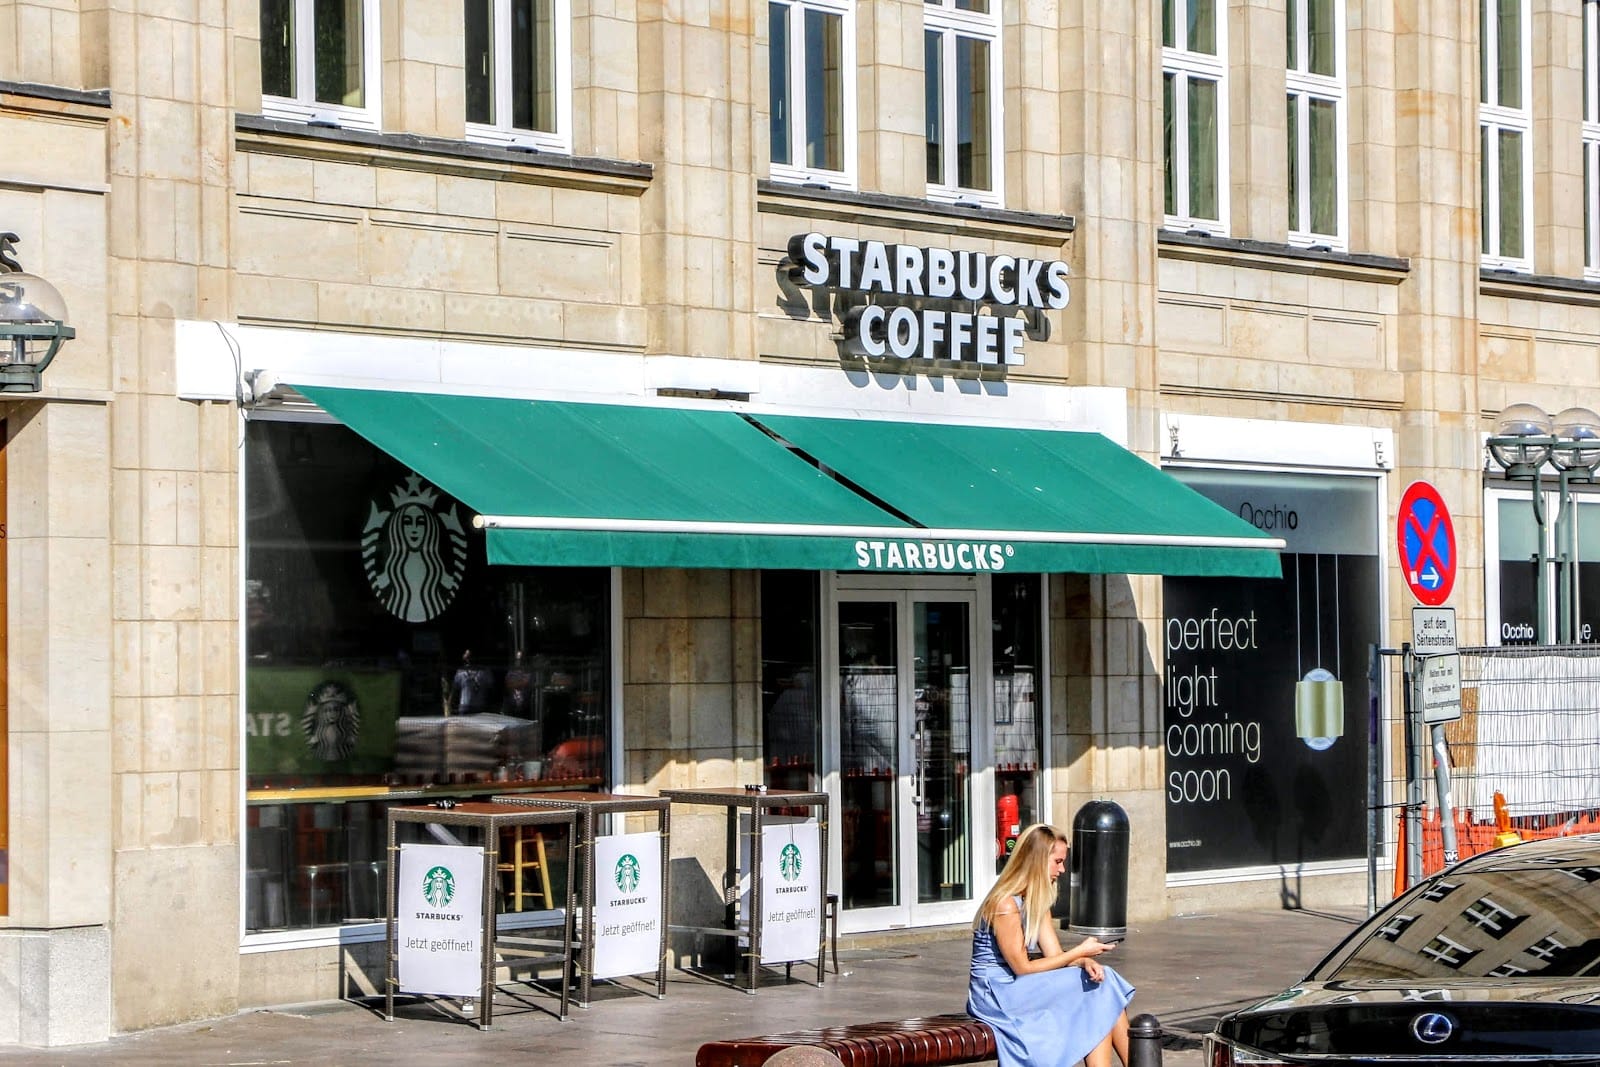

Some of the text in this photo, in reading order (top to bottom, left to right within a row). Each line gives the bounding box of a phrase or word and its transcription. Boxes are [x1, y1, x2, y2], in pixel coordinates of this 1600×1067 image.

[803, 232, 1070, 310] STARBUCKS
[859, 305, 1025, 366] COFFEE
[1240, 502, 1298, 530] Occhio
[1166, 608, 1258, 660] perfect
[1502, 622, 1534, 639] Occhio
[1167, 665, 1218, 718] light
[1167, 712, 1261, 763] coming
[1168, 768, 1231, 803] soon
[601, 919, 656, 937] Jetzt geöffnet!
[767, 906, 817, 923] Jetzt geöffnet!
[405, 936, 474, 953] Jetzt geöffnet!
